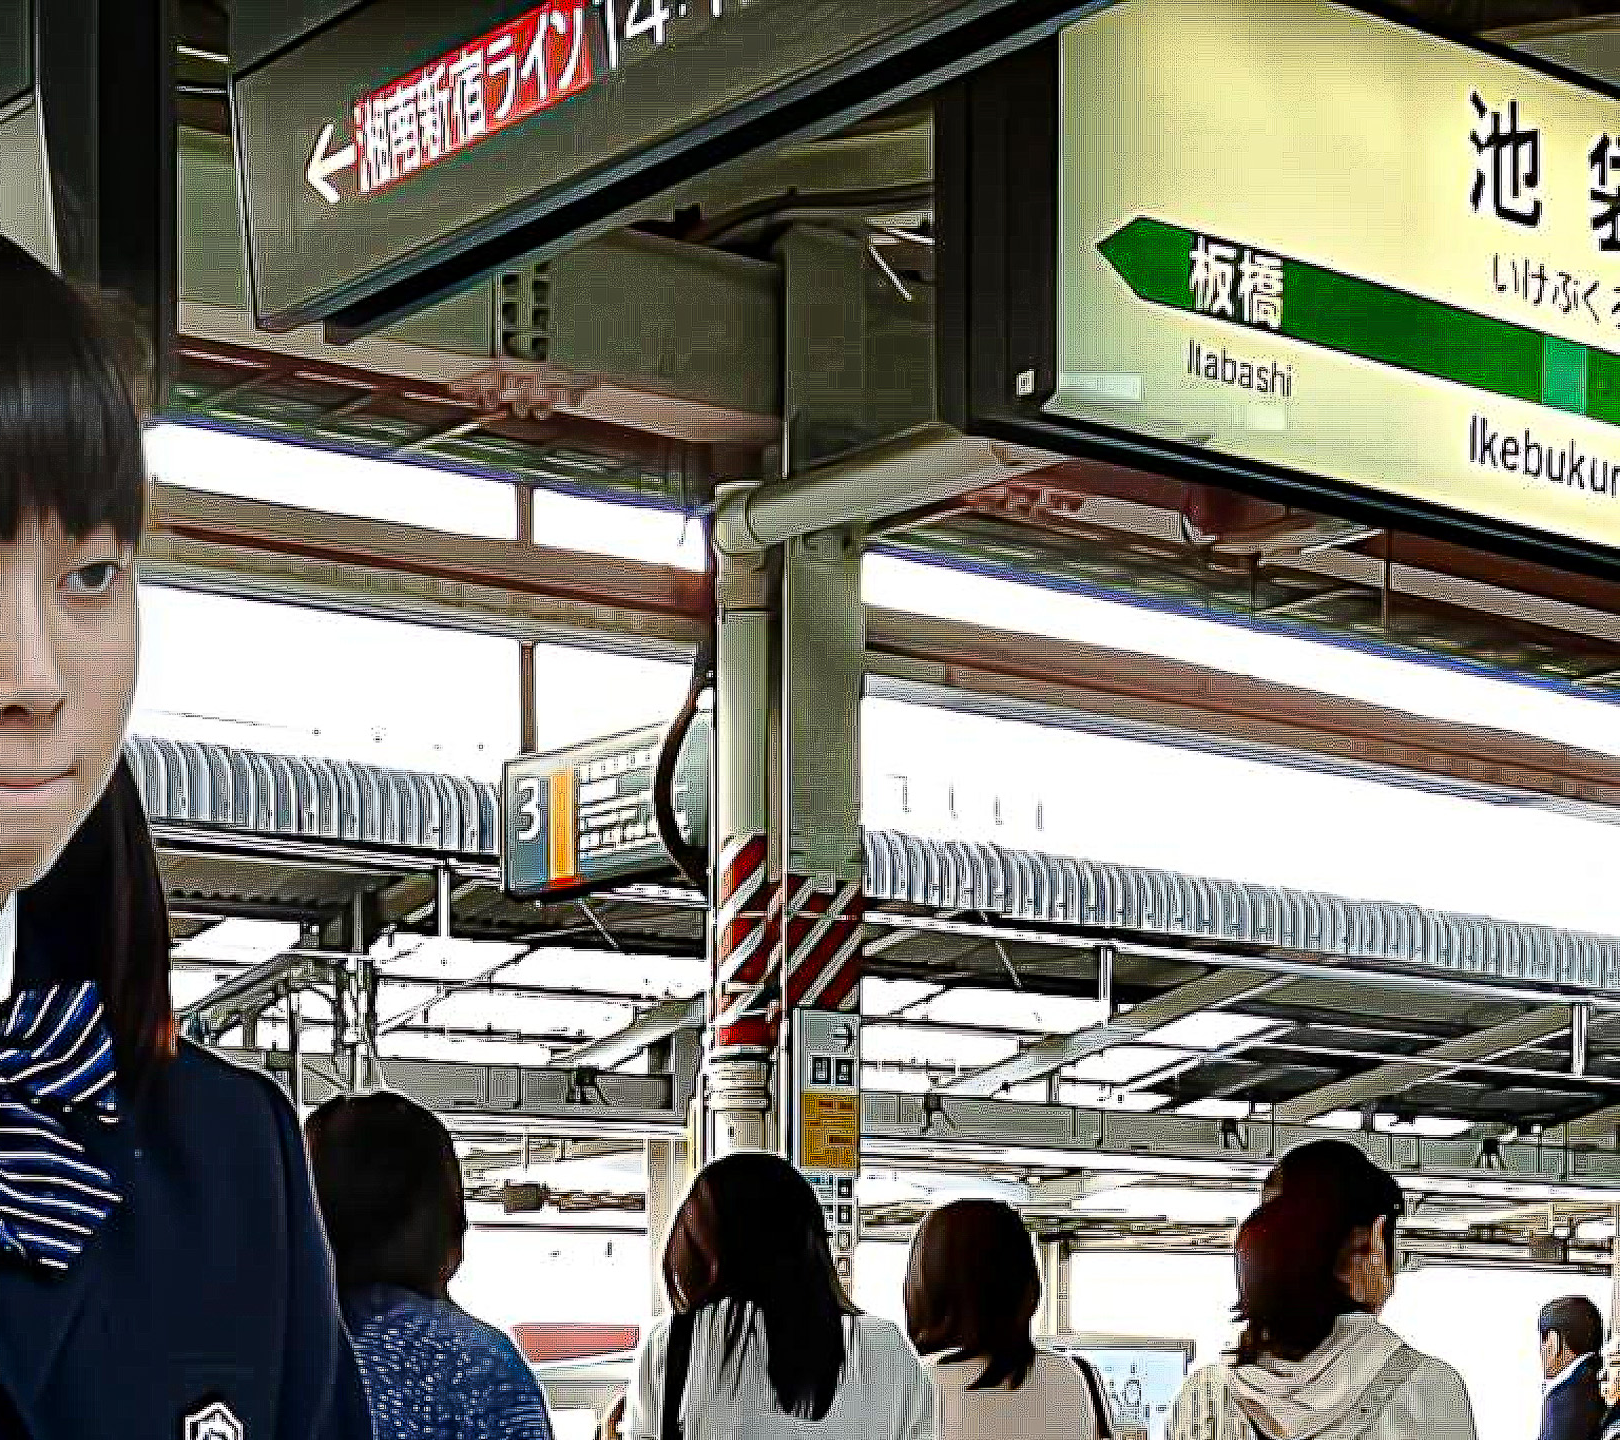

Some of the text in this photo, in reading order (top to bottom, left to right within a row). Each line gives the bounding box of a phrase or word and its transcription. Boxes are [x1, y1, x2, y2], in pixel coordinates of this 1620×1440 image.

[353, 6, 584, 193] 湘南新宿ライン
[1189, 235, 1284, 329] 板橋
[516, 778, 542, 842] 3
